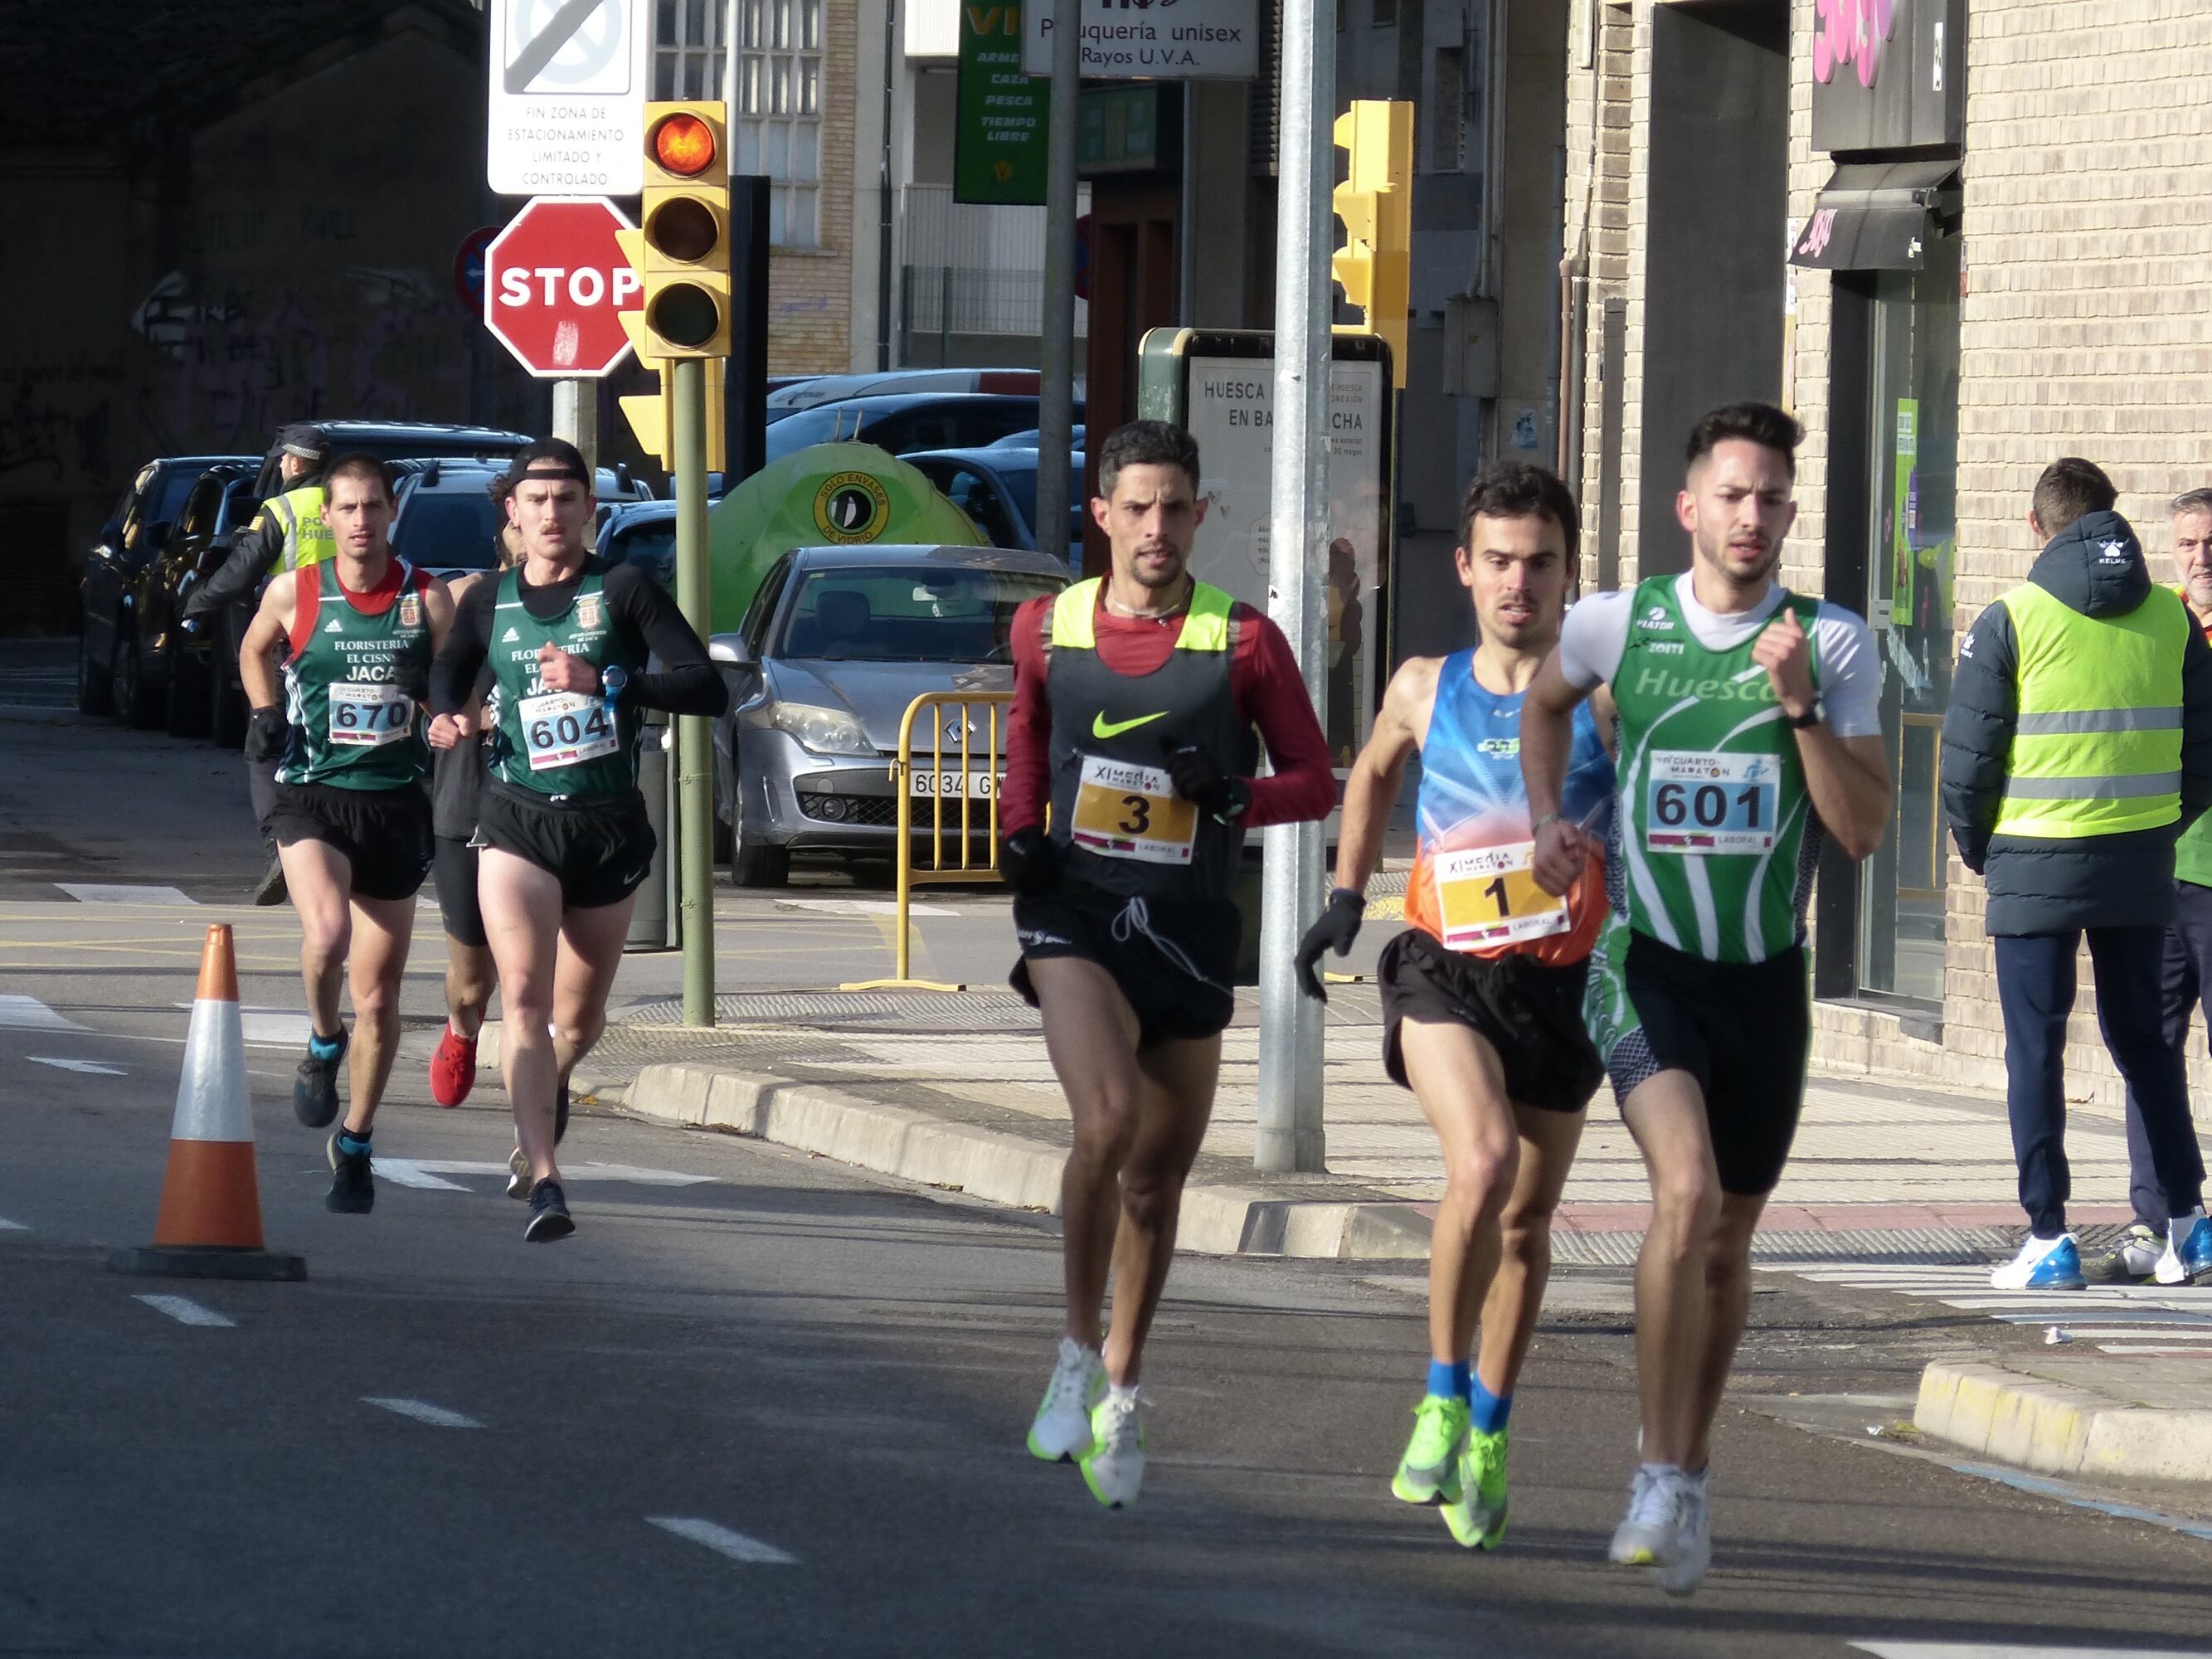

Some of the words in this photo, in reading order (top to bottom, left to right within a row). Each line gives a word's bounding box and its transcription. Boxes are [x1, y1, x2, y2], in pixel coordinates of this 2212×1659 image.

[1172, 23, 1242, 42] unisex
[977, 52, 1019, 63] ARME
[1082, 47, 1133, 68] Rayos
[1140, 48, 1200, 66] U.V.A.
[991, 74, 1028, 85] CAZA
[985, 95, 1033, 106] PESCA
[525, 106, 545, 119] FIN
[551, 107, 587, 119] ZONA
[591, 108, 606, 119] DE
[981, 117, 1036, 128] TIEMPO
[508, 129, 625, 142] ESTACIONAMIENTO
[986, 132, 1030, 142] LIBRE
[532, 151, 591, 163] LIMITADO
[596, 152, 602, 163] Y
[522, 173, 609, 186] CONTROLADO
[498, 266, 641, 307] STOP
[1204, 382, 1265, 399] HUESCA
[1229, 409, 1248, 426] EN
[1254, 410, 1274, 427] BA
[1332, 412, 1363, 430] CHA
[820, 475, 844, 499] SOLO
[848, 474, 886, 506] ENVASES
[302, 517, 323, 528] PO
[303, 529, 333, 540] HUE
[824, 525, 834, 539] DE
[837, 531, 873, 544] VIDRIO
[1636, 620, 1675, 630] VIATOR
[334, 640, 409, 650] FLORISTERIA
[347, 654, 359, 664] EL
[362, 654, 391, 664] CISN
[346, 665, 396, 682] JACA
[1635, 668, 1781, 702] Huesca
[336, 703, 408, 730] 670
[530, 708, 609, 750] 604
[1655, 783, 1762, 828] 601
[1117, 795, 1151, 834] 3
[1484, 876, 1510, 918] 1
